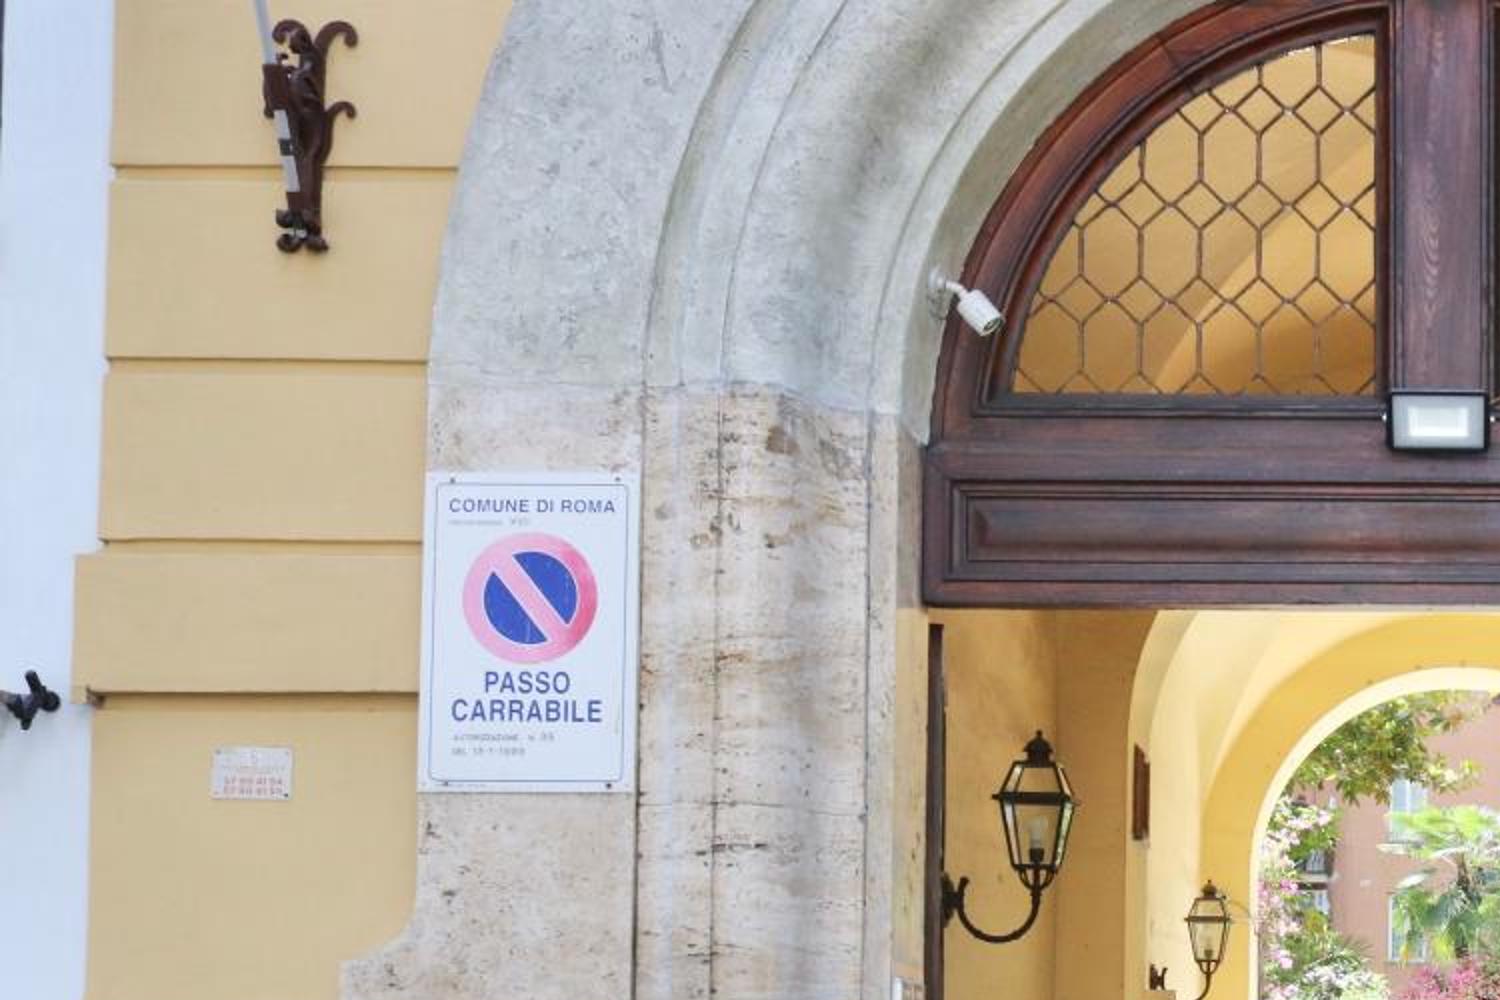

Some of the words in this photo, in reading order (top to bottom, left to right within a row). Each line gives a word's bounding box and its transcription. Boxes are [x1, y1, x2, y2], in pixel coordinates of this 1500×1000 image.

[449, 498, 528, 513] COMUNE
[536, 498, 554, 513] DI
[561, 499, 615, 513] ROMA
[484, 671, 571, 694] PASSO
[451, 699, 603, 723] CARRABILE
